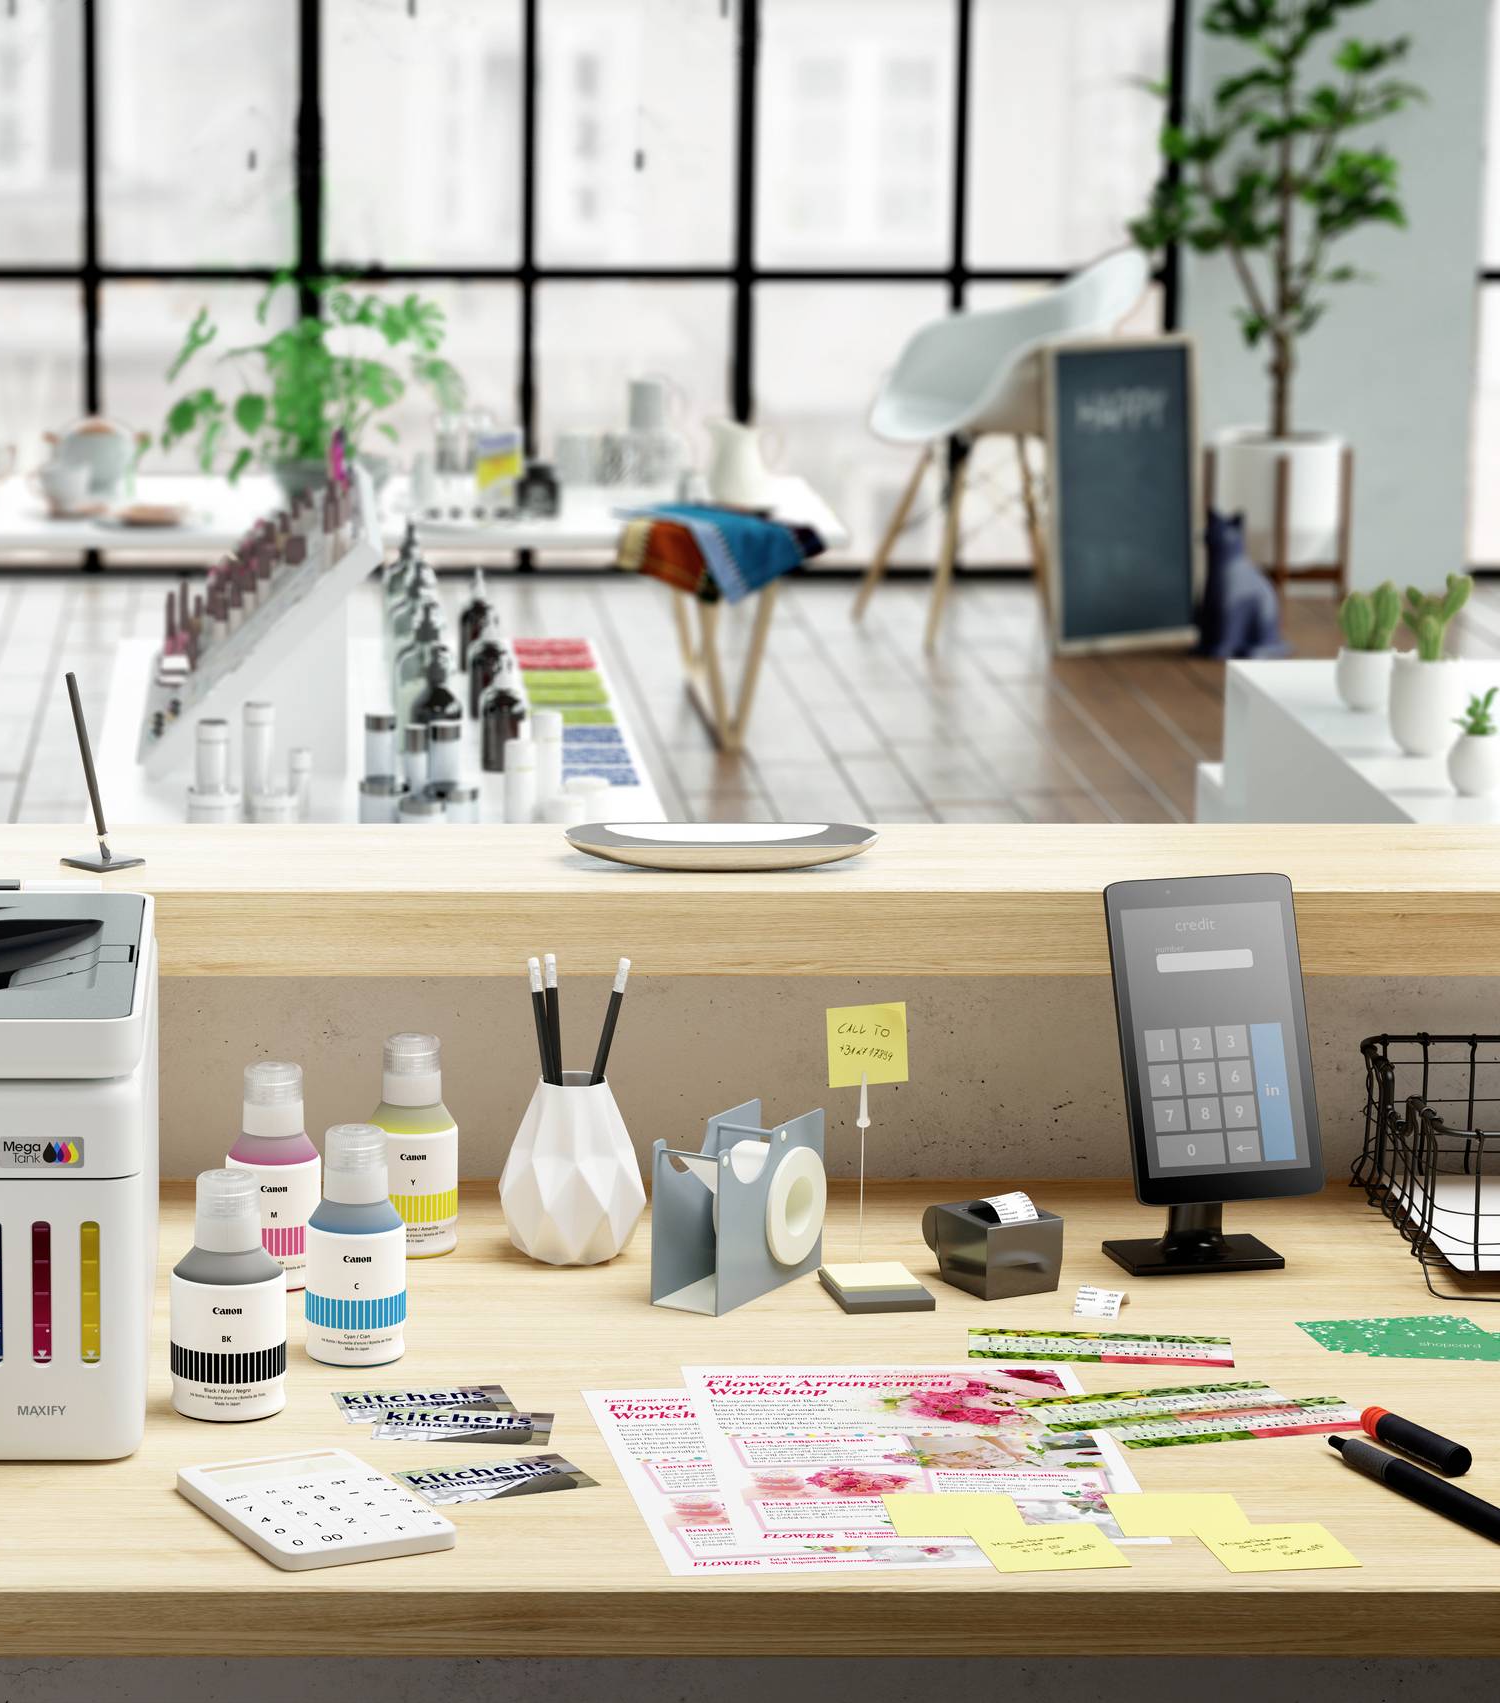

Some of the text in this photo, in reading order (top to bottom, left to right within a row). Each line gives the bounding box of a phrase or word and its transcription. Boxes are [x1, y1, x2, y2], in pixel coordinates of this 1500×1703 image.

[1174, 917, 1216, 932] credit
[837, 1022, 890, 1038] CALL TO
[1159, 1035, 1236, 1052] 1 2 3
[1161, 1070, 1240, 1088] 4 5 6
[1265, 1084, 1281, 1097] in
[1165, 1105, 1244, 1122] 7 8 9
[3, 1141, 41, 1154] Mega
[1187, 1143, 1196, 1157] 0
[13, 1152, 41, 1164] Tank
[400, 1152, 427, 1161] Canon
[260, 1185, 288, 1193] Canon
[343, 1255, 372, 1263] Canon
[212, 1306, 243, 1315] Canon
[221, 1335, 232, 1343] BK
[1419, 1340, 1482, 1349] shopcard
[706, 1380, 952, 1388] Flower Arrangement
[342, 1390, 487, 1405] kitchens
[708, 1388, 828, 1396] Workshop
[17, 1404, 67, 1417] MAXIFY
[348, 1401, 413, 1410] cocinas
[608, 1404, 688, 1412] Flower
[386, 1411, 532, 1425] kitchens
[613, 1411, 696, 1420] Worksh
[384, 1420, 451, 1428] cocinas
[407, 1460, 552, 1485] kitchens
[420, 1478, 484, 1491] cocinas
[321, 1533, 344, 1543] 00
